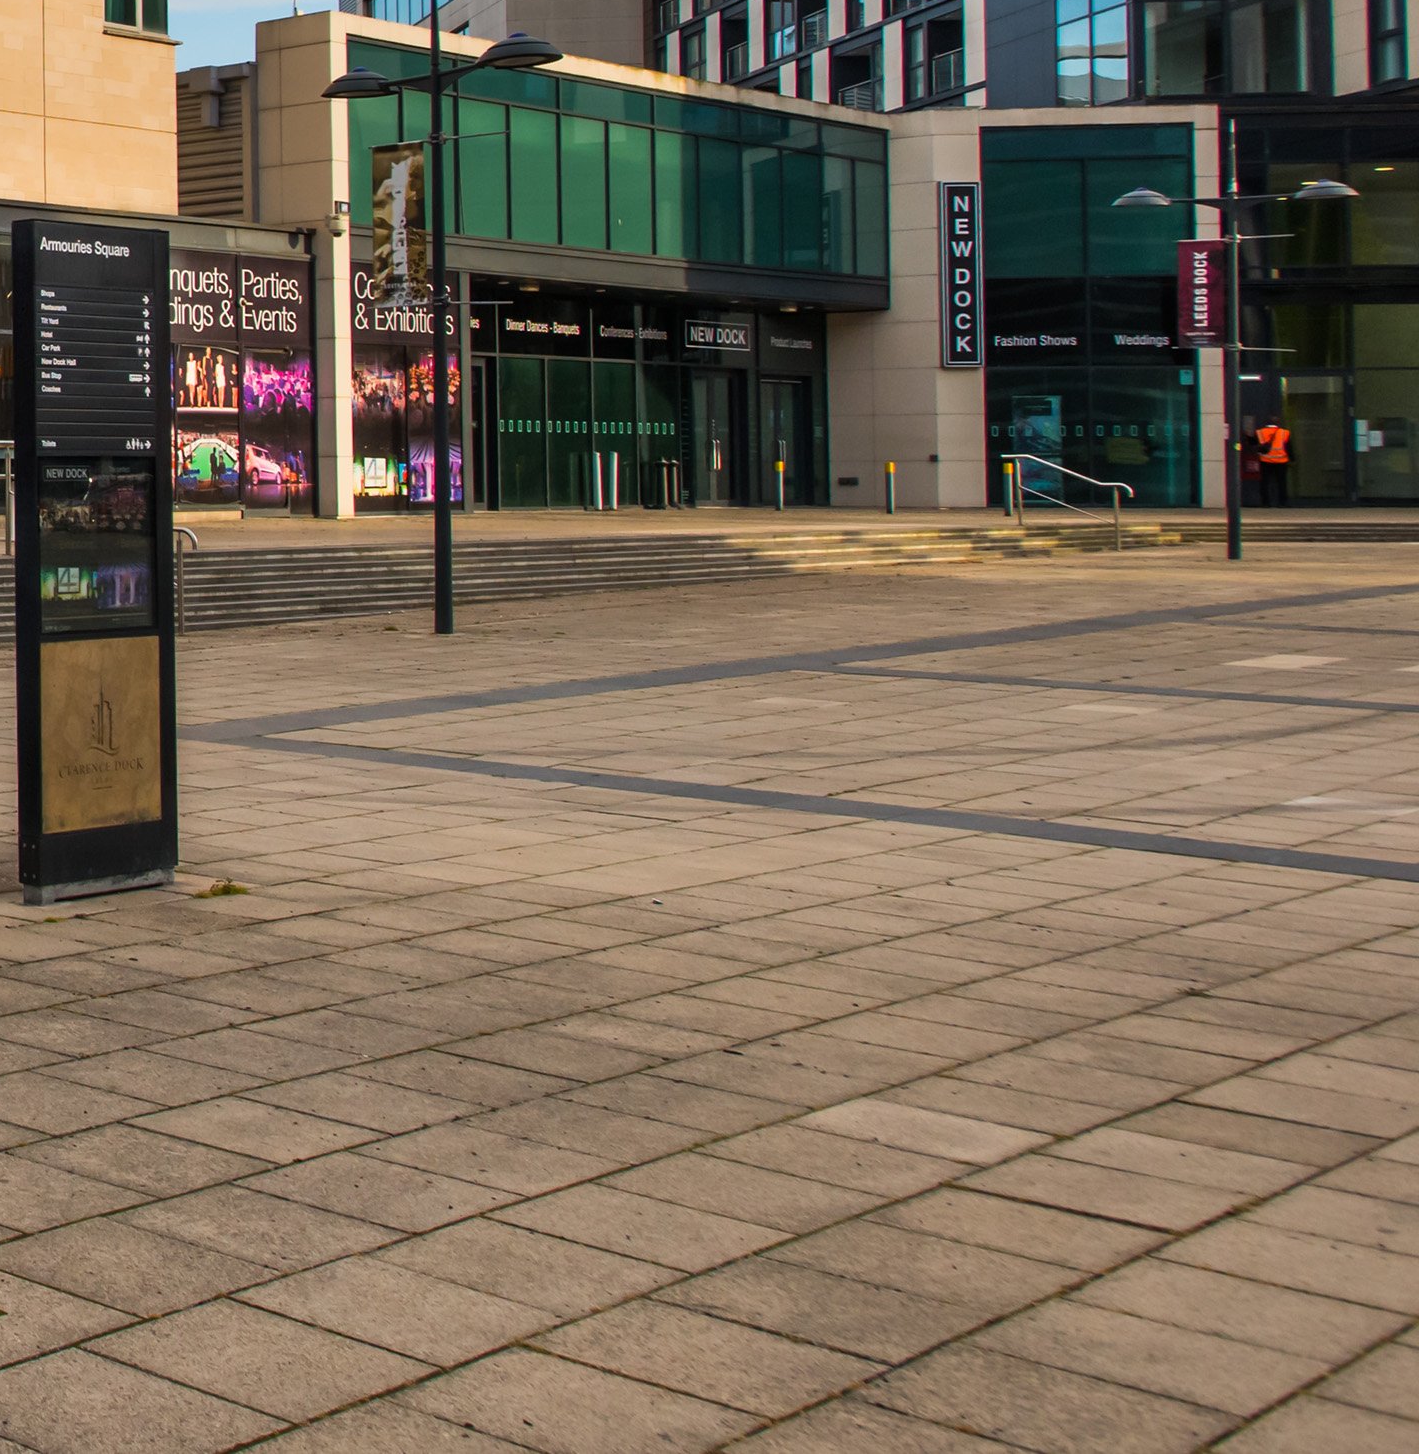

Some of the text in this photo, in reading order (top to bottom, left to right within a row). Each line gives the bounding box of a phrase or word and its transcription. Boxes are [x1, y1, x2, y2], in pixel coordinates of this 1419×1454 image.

[40, 236, 130, 258] Armouries Square
[951, 195, 973, 353] NEW DOCK
[1193, 252, 1208, 284] DOCK
[169, 267, 303, 305] nquets, Parties,
[169, 296, 297, 333] dings & Events
[354, 303, 369, 330] &
[1193, 288, 1208, 327] LEEDS
[505, 318, 525, 331] Dinner
[526, 319, 549, 333] Dances
[553, 321, 580, 336] Banquets
[690, 326, 746, 345] NEW DOCK
[50, 344, 61, 352] Park
[994, 335, 1077, 346] Fashion Shows
[1114, 334, 1170, 347] Weddings
[46, 468, 64, 478] NEW
[66, 468, 88, 478] DOCK
[114, 757, 144, 771] DOCK
